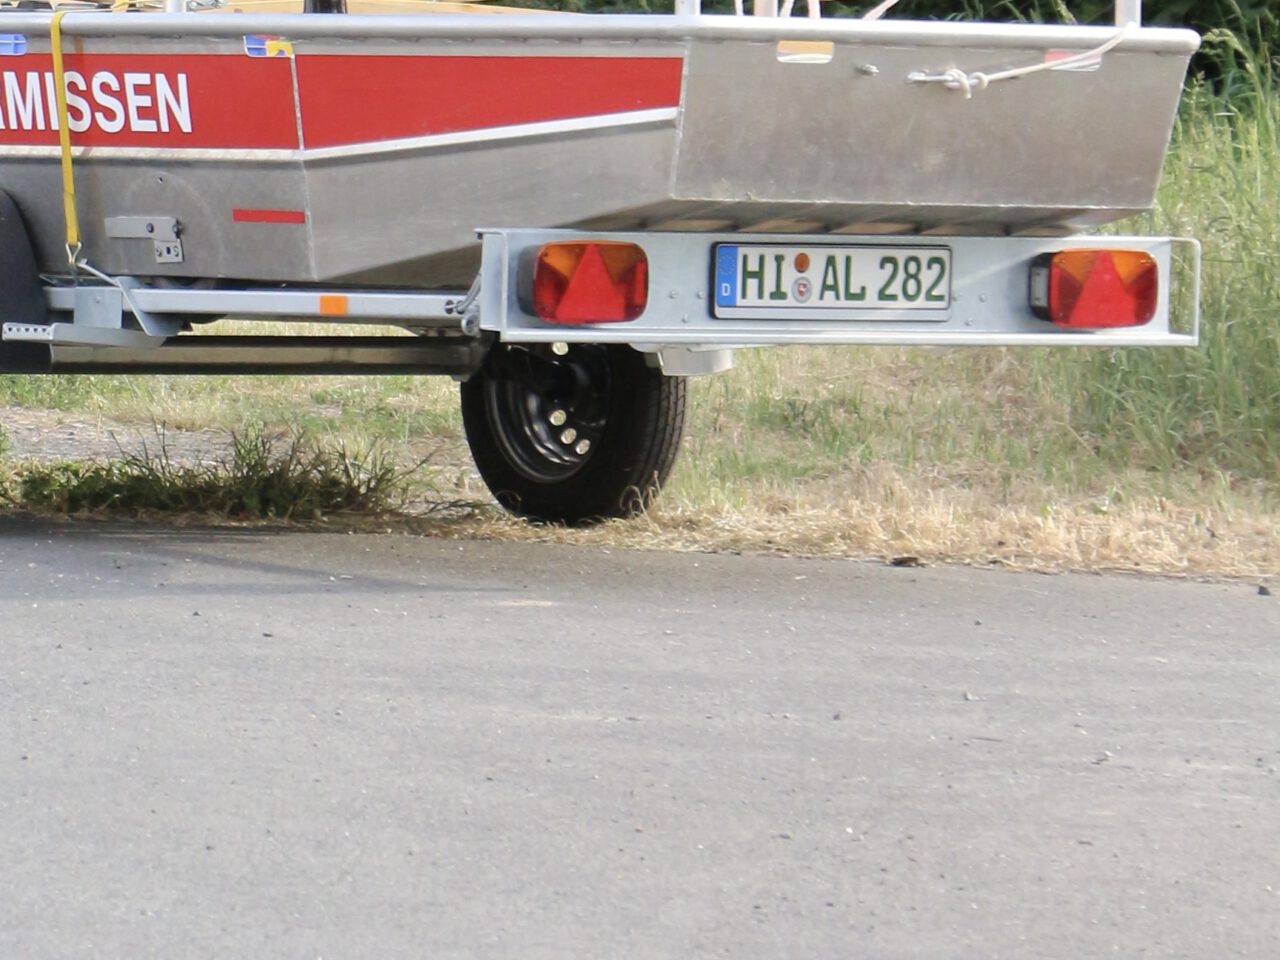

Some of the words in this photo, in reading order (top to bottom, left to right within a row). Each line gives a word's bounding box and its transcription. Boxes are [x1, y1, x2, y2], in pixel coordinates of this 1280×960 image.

[721, 282, 731, 296] D
[741, 254, 788, 300] HI
[819, 255, 866, 301] AL
[878, 256, 947, 302] 282
